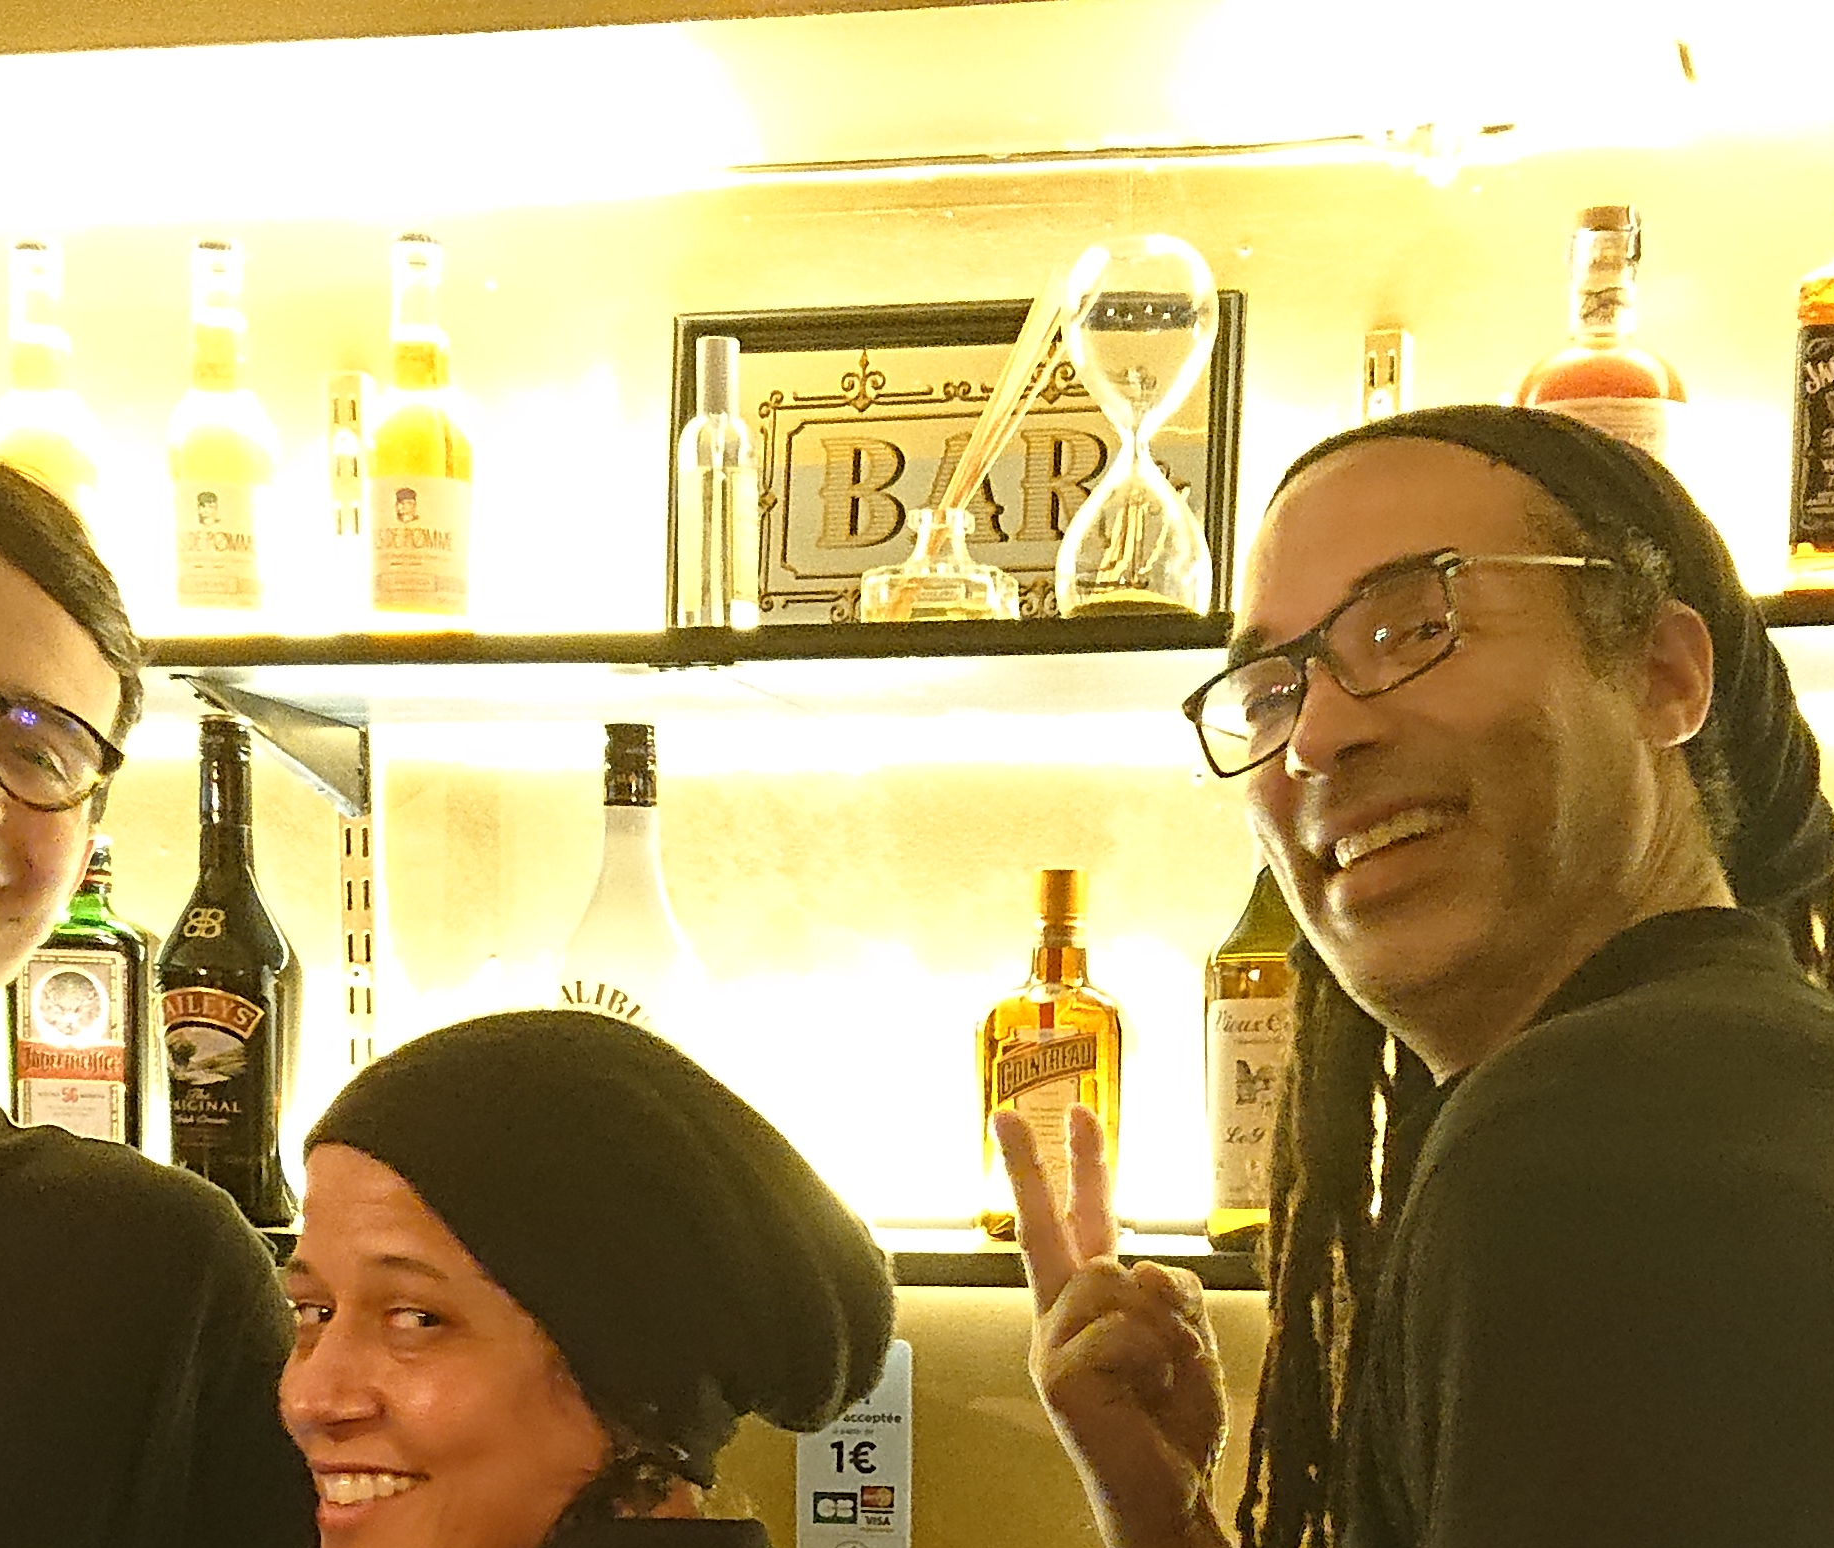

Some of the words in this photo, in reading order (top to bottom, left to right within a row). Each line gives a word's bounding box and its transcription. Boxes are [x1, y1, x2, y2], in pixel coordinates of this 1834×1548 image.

[816, 424, 1110, 551] BAR
[165, 993, 256, 1026] AILEYS
[562, 980, 650, 1024] ALIBU
[1000, 1041, 1095, 1097] COINTREAU
[173, 1100, 242, 1113] RIGINAL
[830, 1439, 877, 1474] 1€
[865, 1515, 891, 1526] VISA
